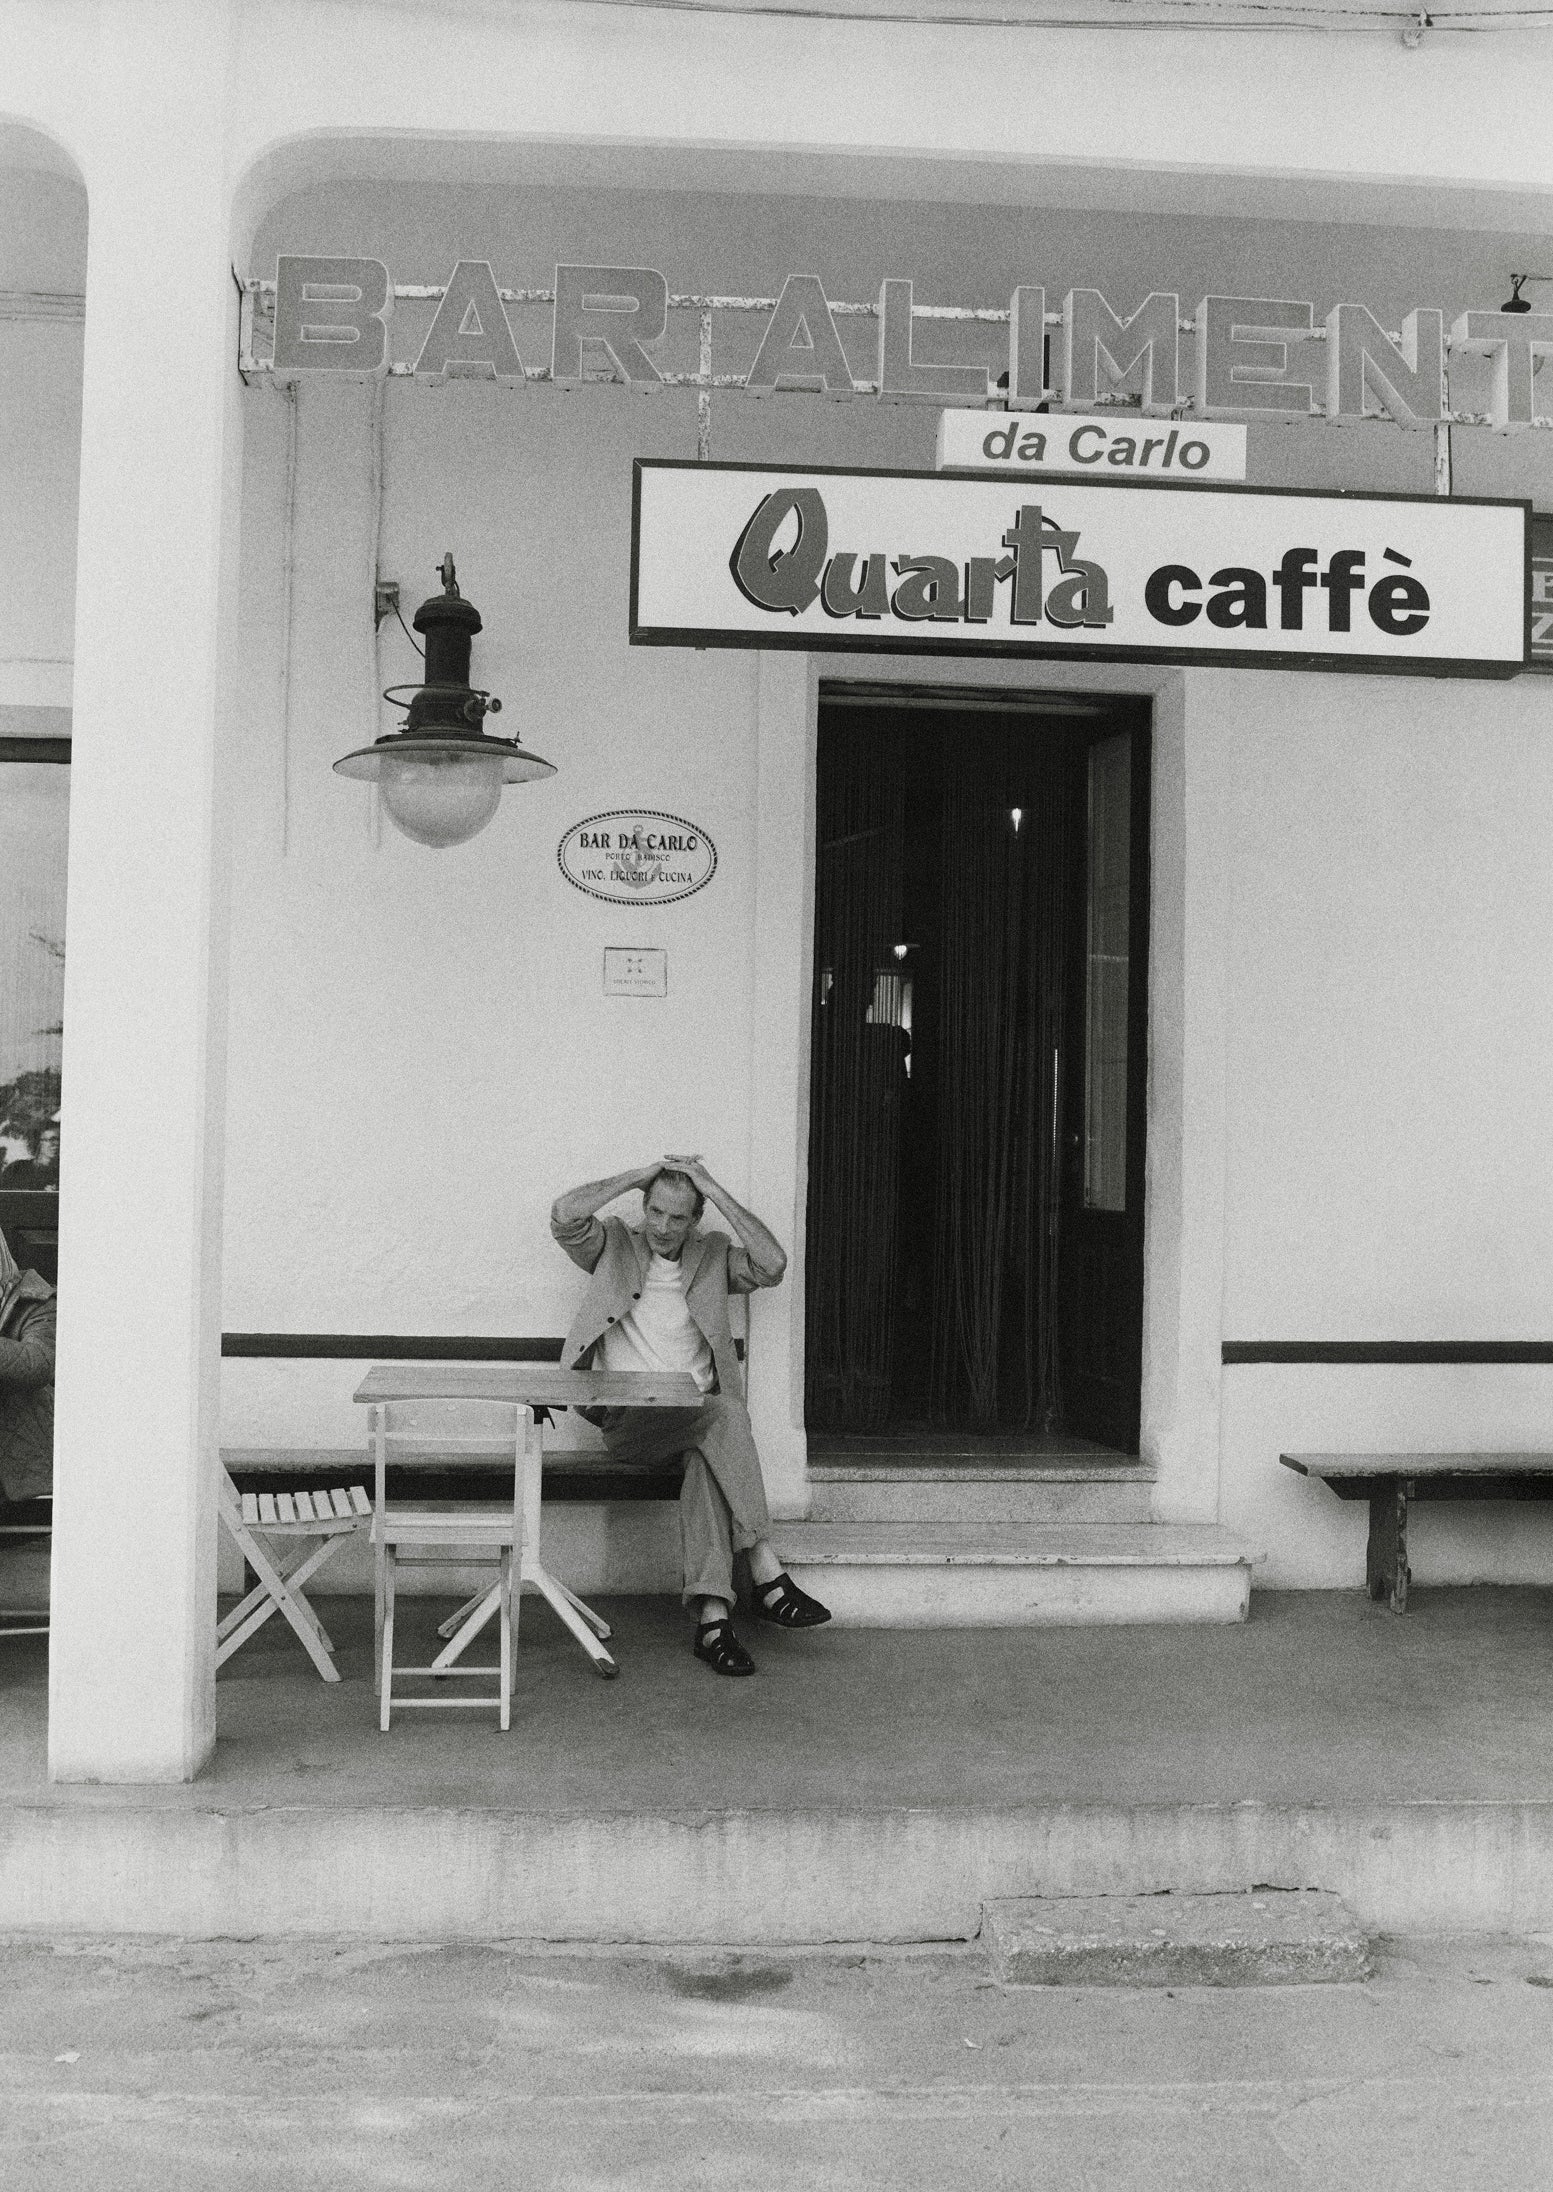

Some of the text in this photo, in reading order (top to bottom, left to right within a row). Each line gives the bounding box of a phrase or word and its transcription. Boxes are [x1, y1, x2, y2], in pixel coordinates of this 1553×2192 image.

[273, 254, 1553, 431] BAR ALIMENT
[982, 421, 1211, 470] da Carlo
[729, 487, 1430, 635] Quarta caffè
[580, 832, 698, 851] BAR DA CARLO
[658, 871, 693, 884] CUCINA
